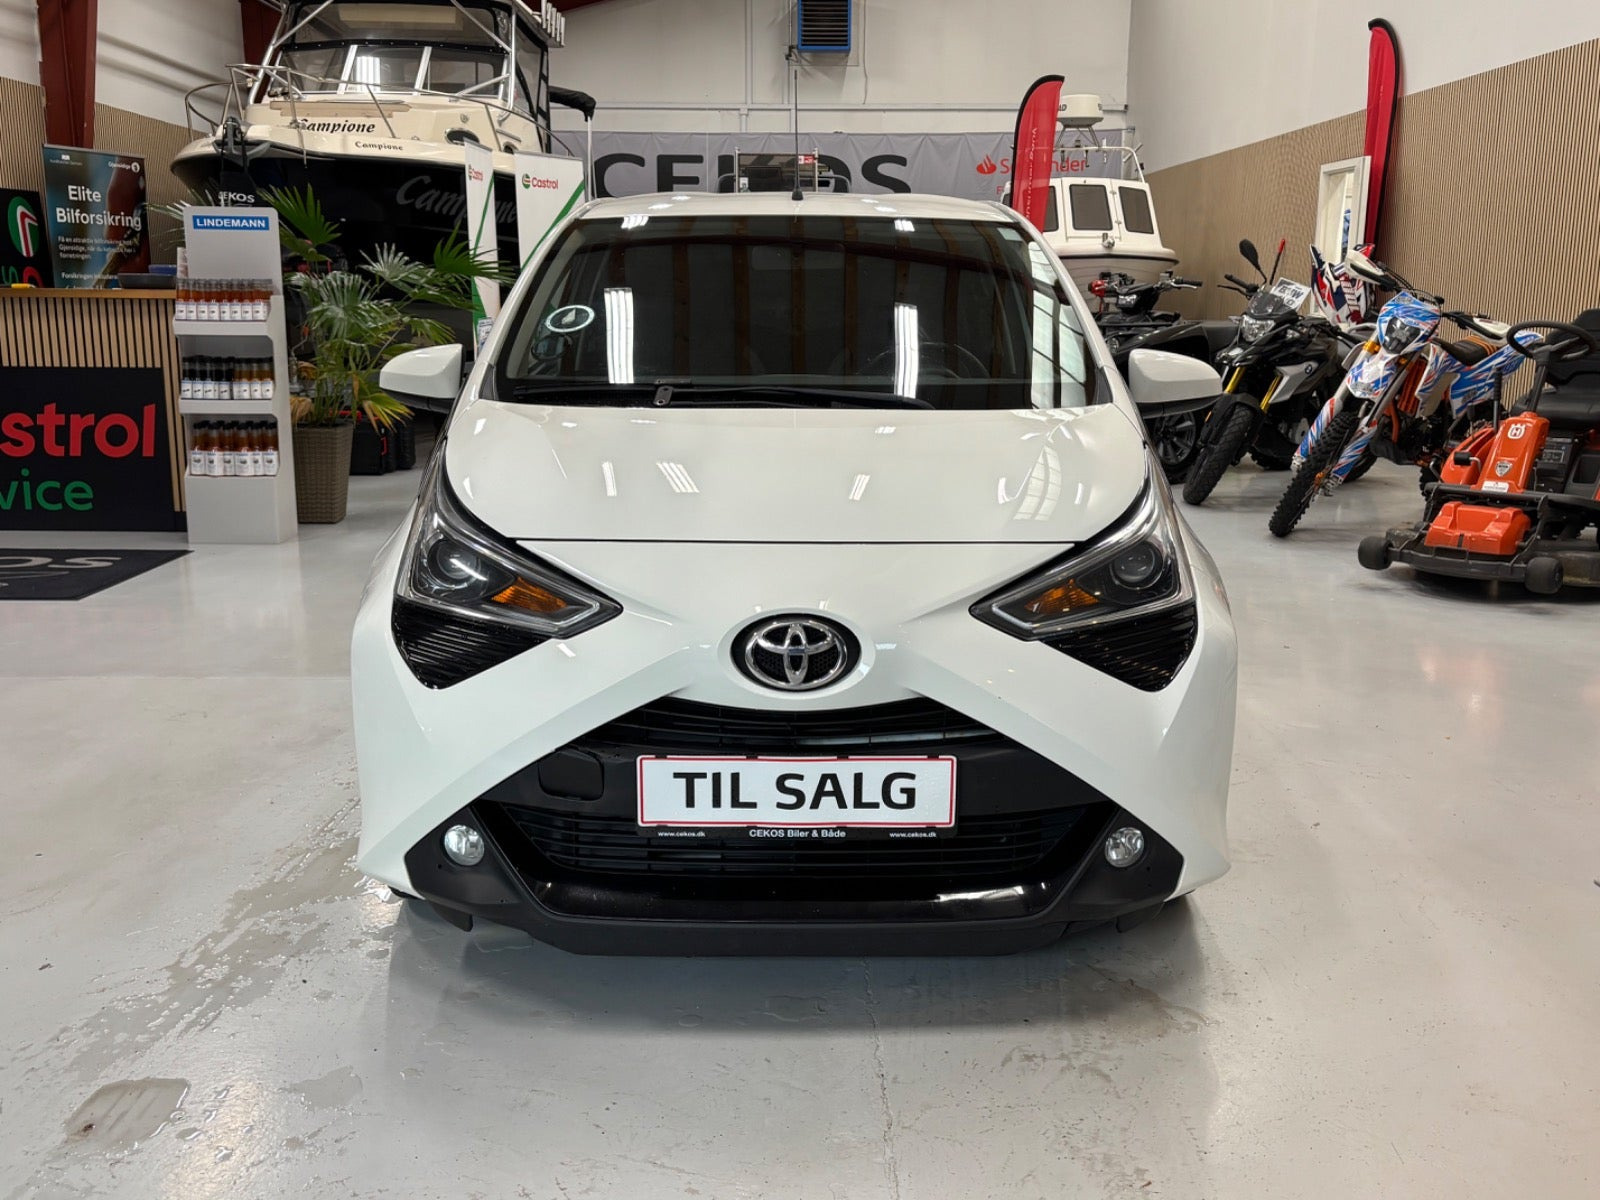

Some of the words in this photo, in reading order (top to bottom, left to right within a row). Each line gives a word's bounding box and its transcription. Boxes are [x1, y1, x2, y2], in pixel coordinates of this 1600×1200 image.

[354, 141, 404, 151] Campione
[531, 176, 559, 190] Castrol
[67, 184, 102, 203] Elite
[55, 206, 142, 231] Bilforsikring
[196, 217, 266, 228] LINDEMANN
[672, 771, 758, 809] TIL
[775, 771, 917, 811] SALG
[657, 830, 706, 838] www.cekos.dk
[749, 828, 785, 838] CEKOS
[787, 828, 809, 838] Biler
[811, 829, 819, 838] &
[821, 828, 846, 838] Både
[889, 831, 937, 839] www.cekos.dk
